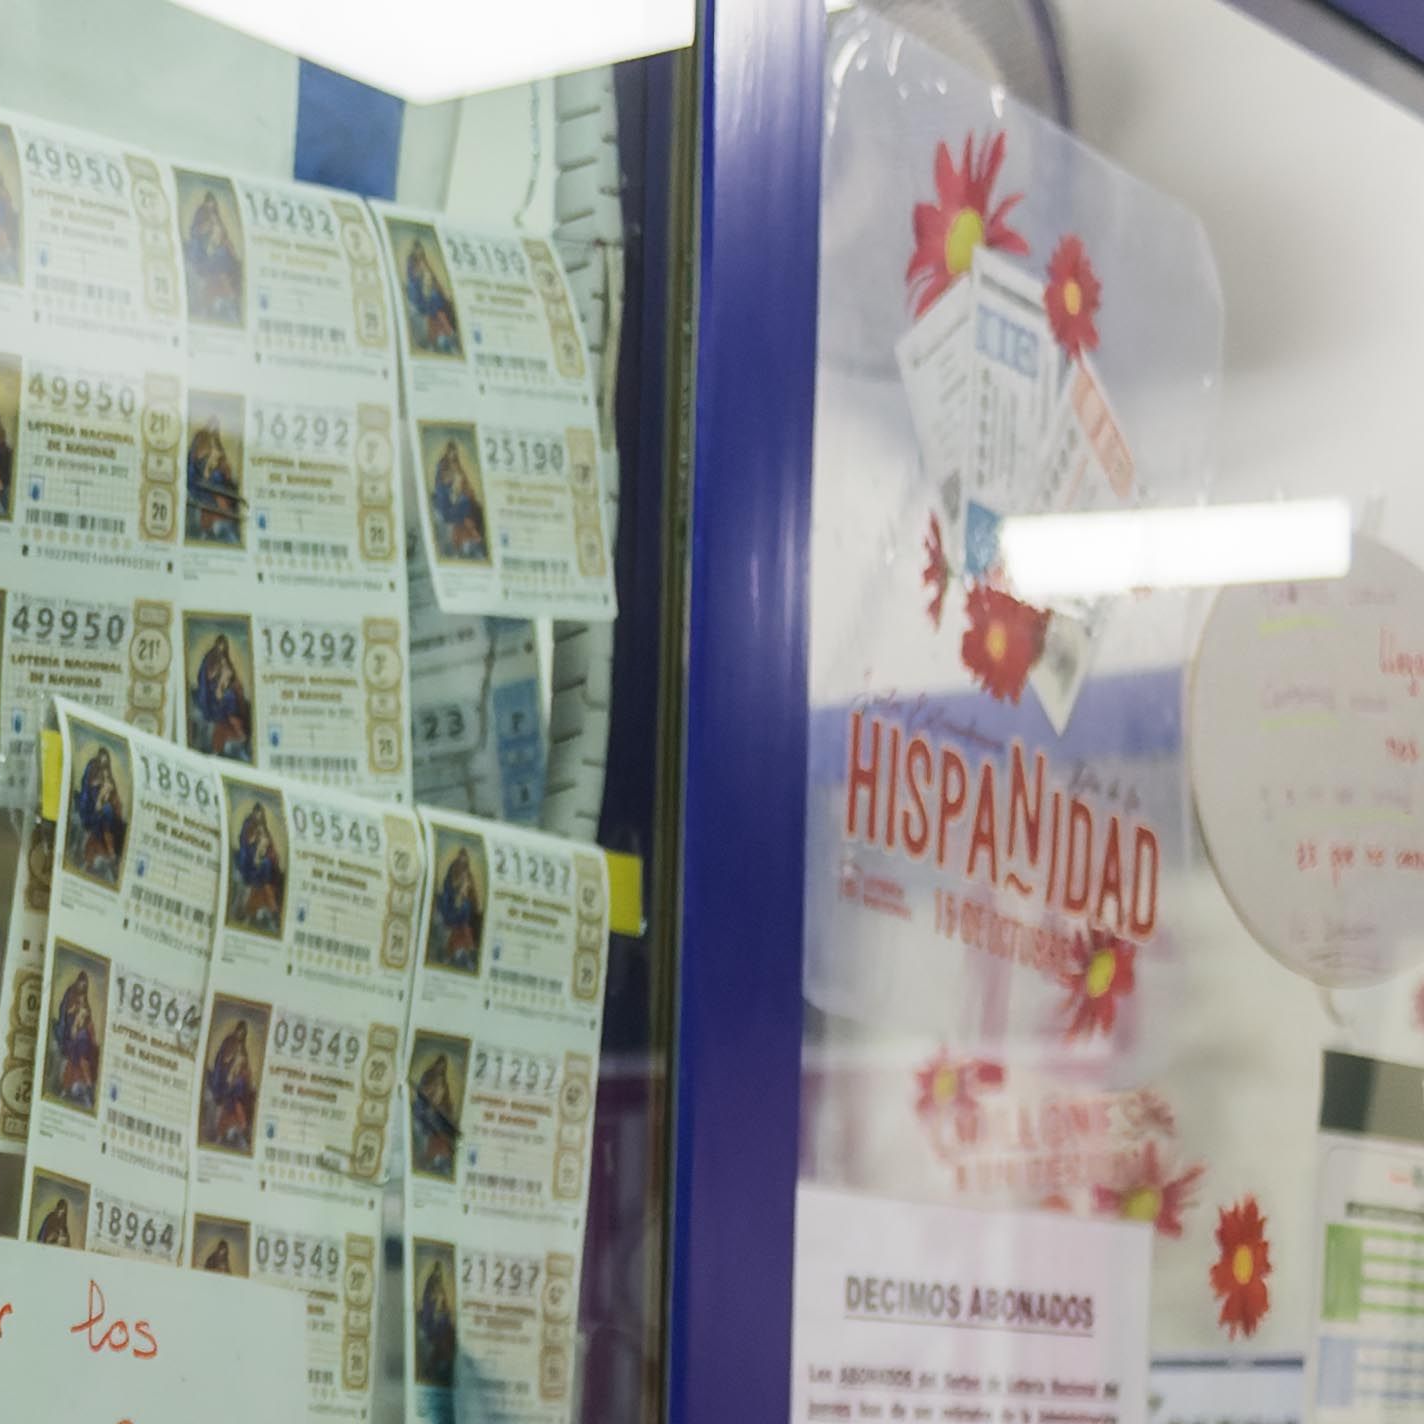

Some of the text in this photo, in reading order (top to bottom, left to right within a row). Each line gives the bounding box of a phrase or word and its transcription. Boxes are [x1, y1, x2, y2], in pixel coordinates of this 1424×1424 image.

[24, 142, 125, 191] 49950
[12, 607, 126, 645] 49950
[94, 1200, 176, 1253] 18964
[255, 1235, 340, 1277] 09549
[461, 1259, 541, 1292] 21297
[70, 1280, 158, 1359] los
[844, 1275, 1094, 1330] DECIMOS ABONADOS
